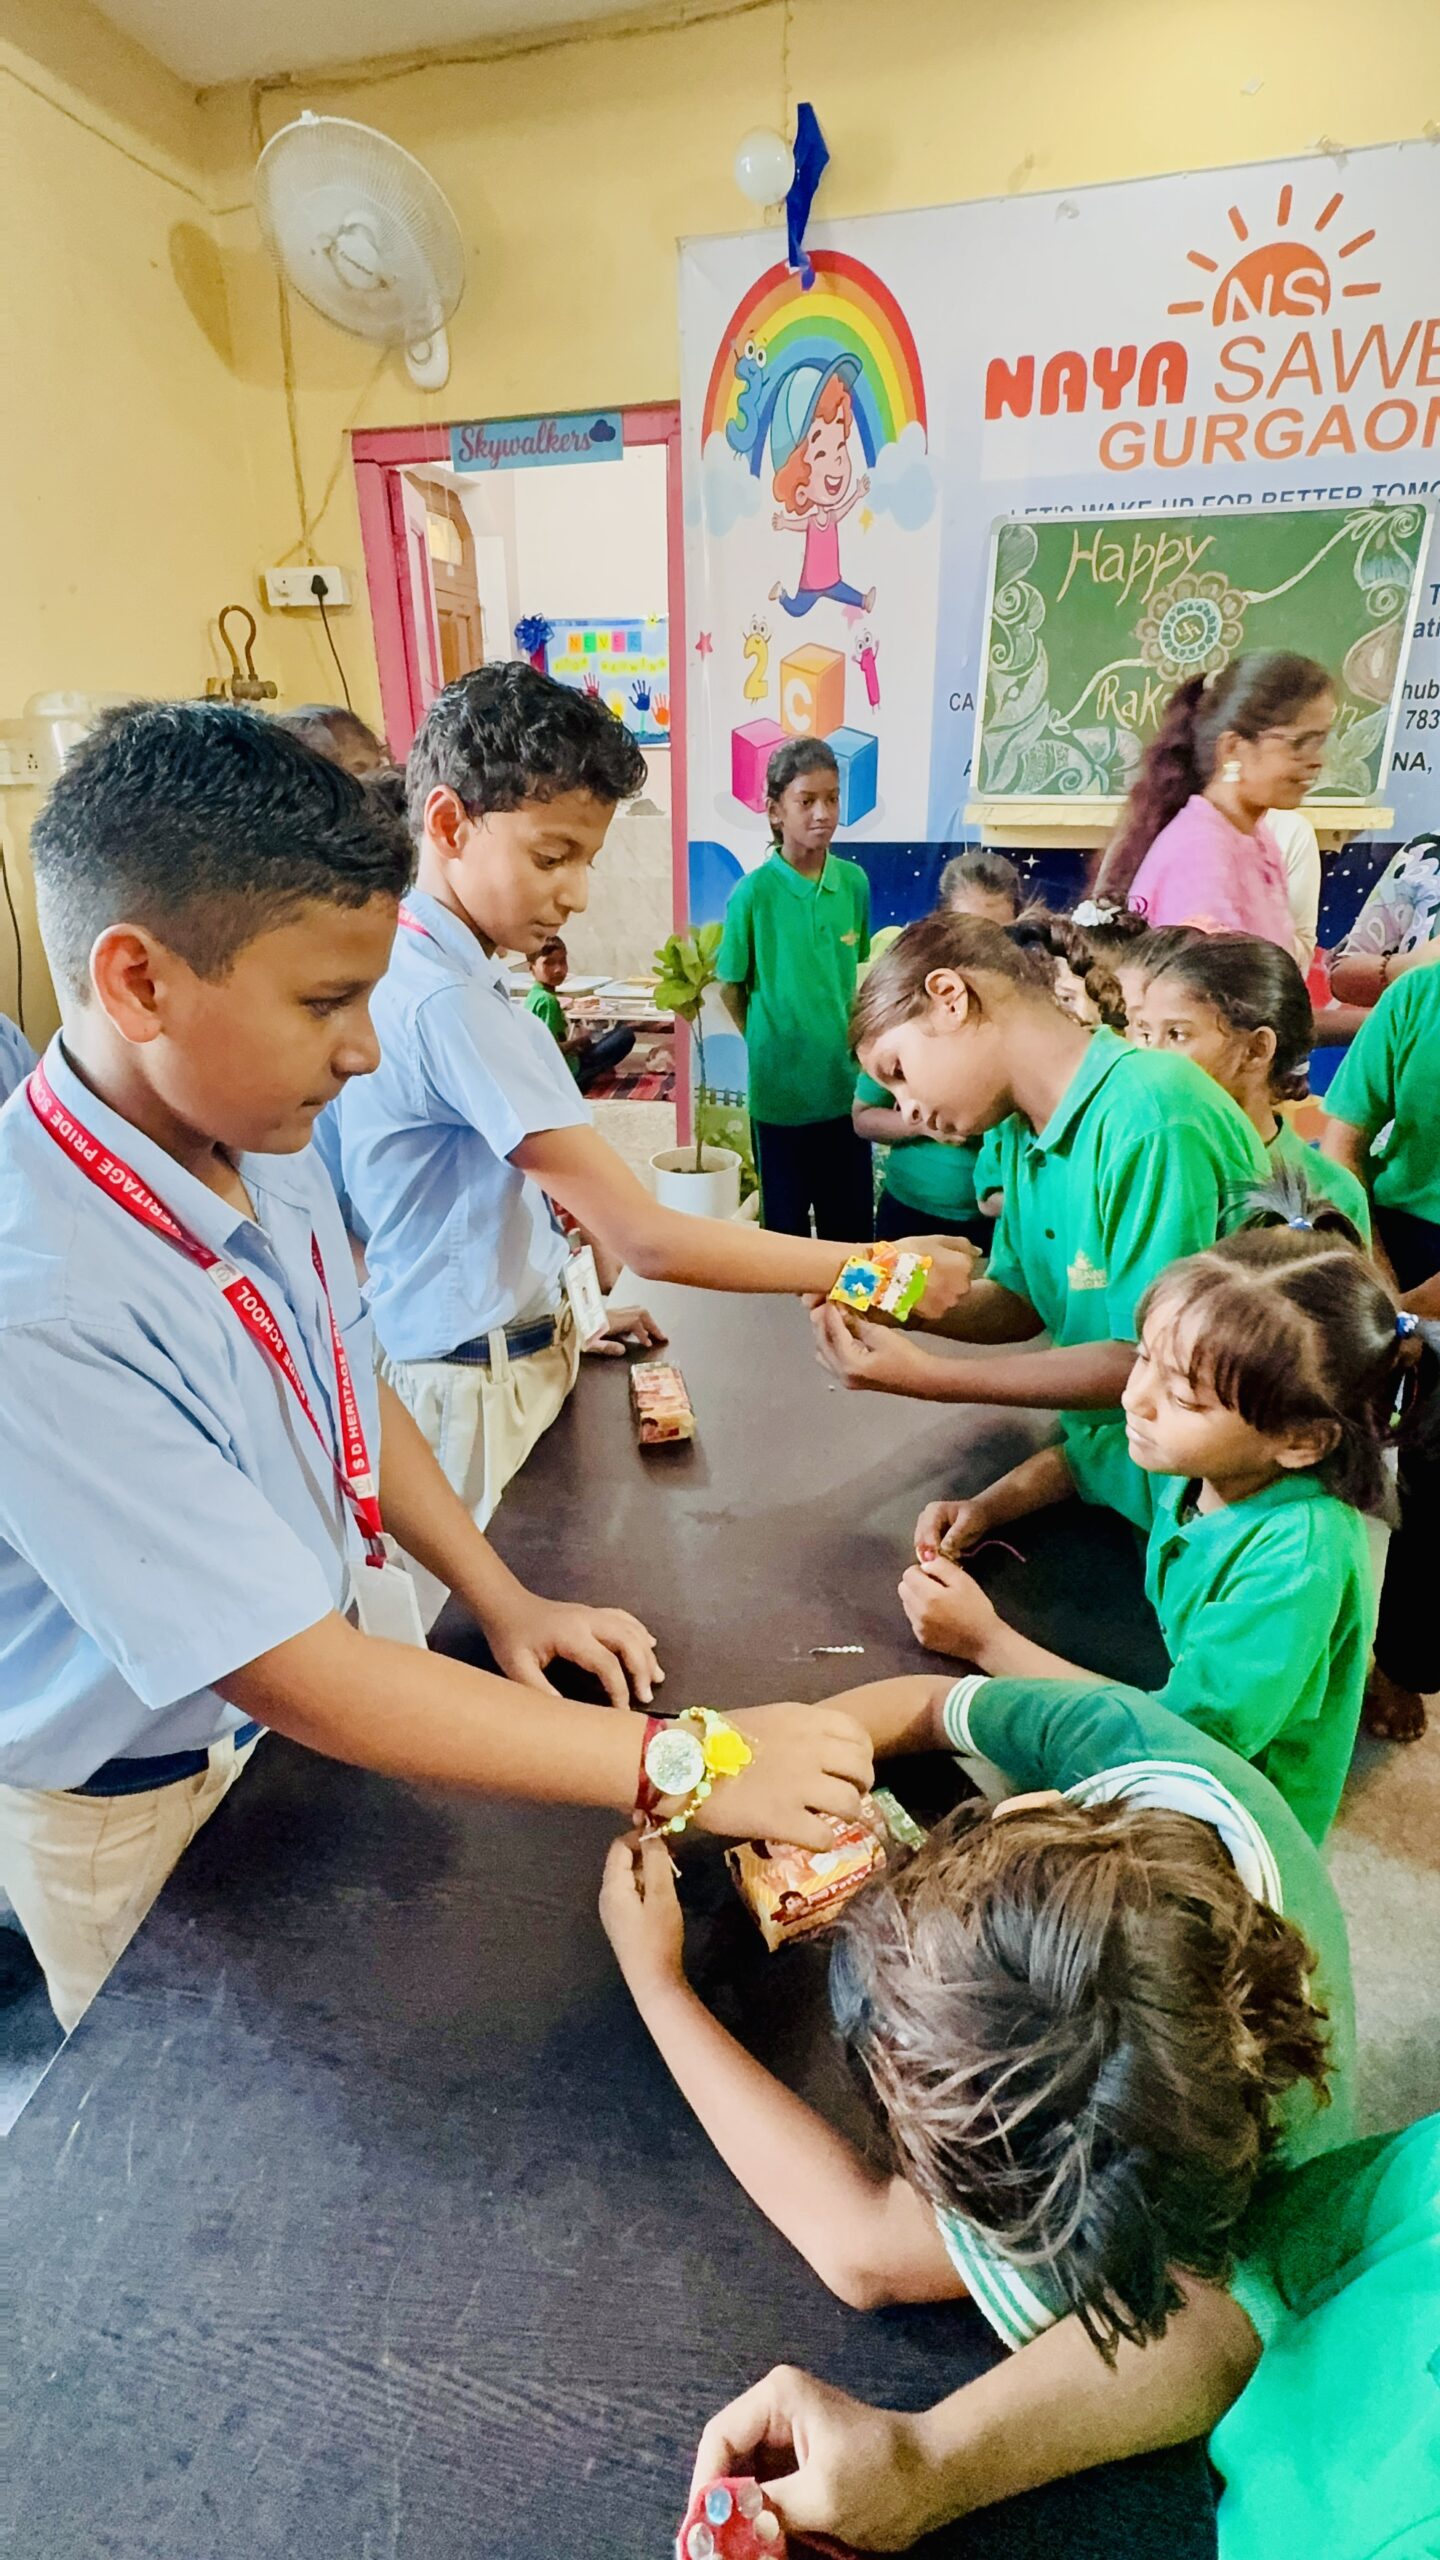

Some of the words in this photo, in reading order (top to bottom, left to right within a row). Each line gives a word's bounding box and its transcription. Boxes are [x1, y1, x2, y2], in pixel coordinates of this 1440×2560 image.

[1225, 266, 1325, 323] NS
[985, 341, 1188, 420] NAYA
[458, 417, 592, 469] Skywalkers
[1057, 528, 1217, 607] Happy
[50, 1110, 98, 1161] PRIDE
[96, 1157, 182, 1237] ERITAGE
[236, 1285, 283, 1353] SCHOOL
[338, 1353, 360, 1438] HERITAGE
[351, 1443, 363, 1456] D
[352, 1456, 365, 1470] S
